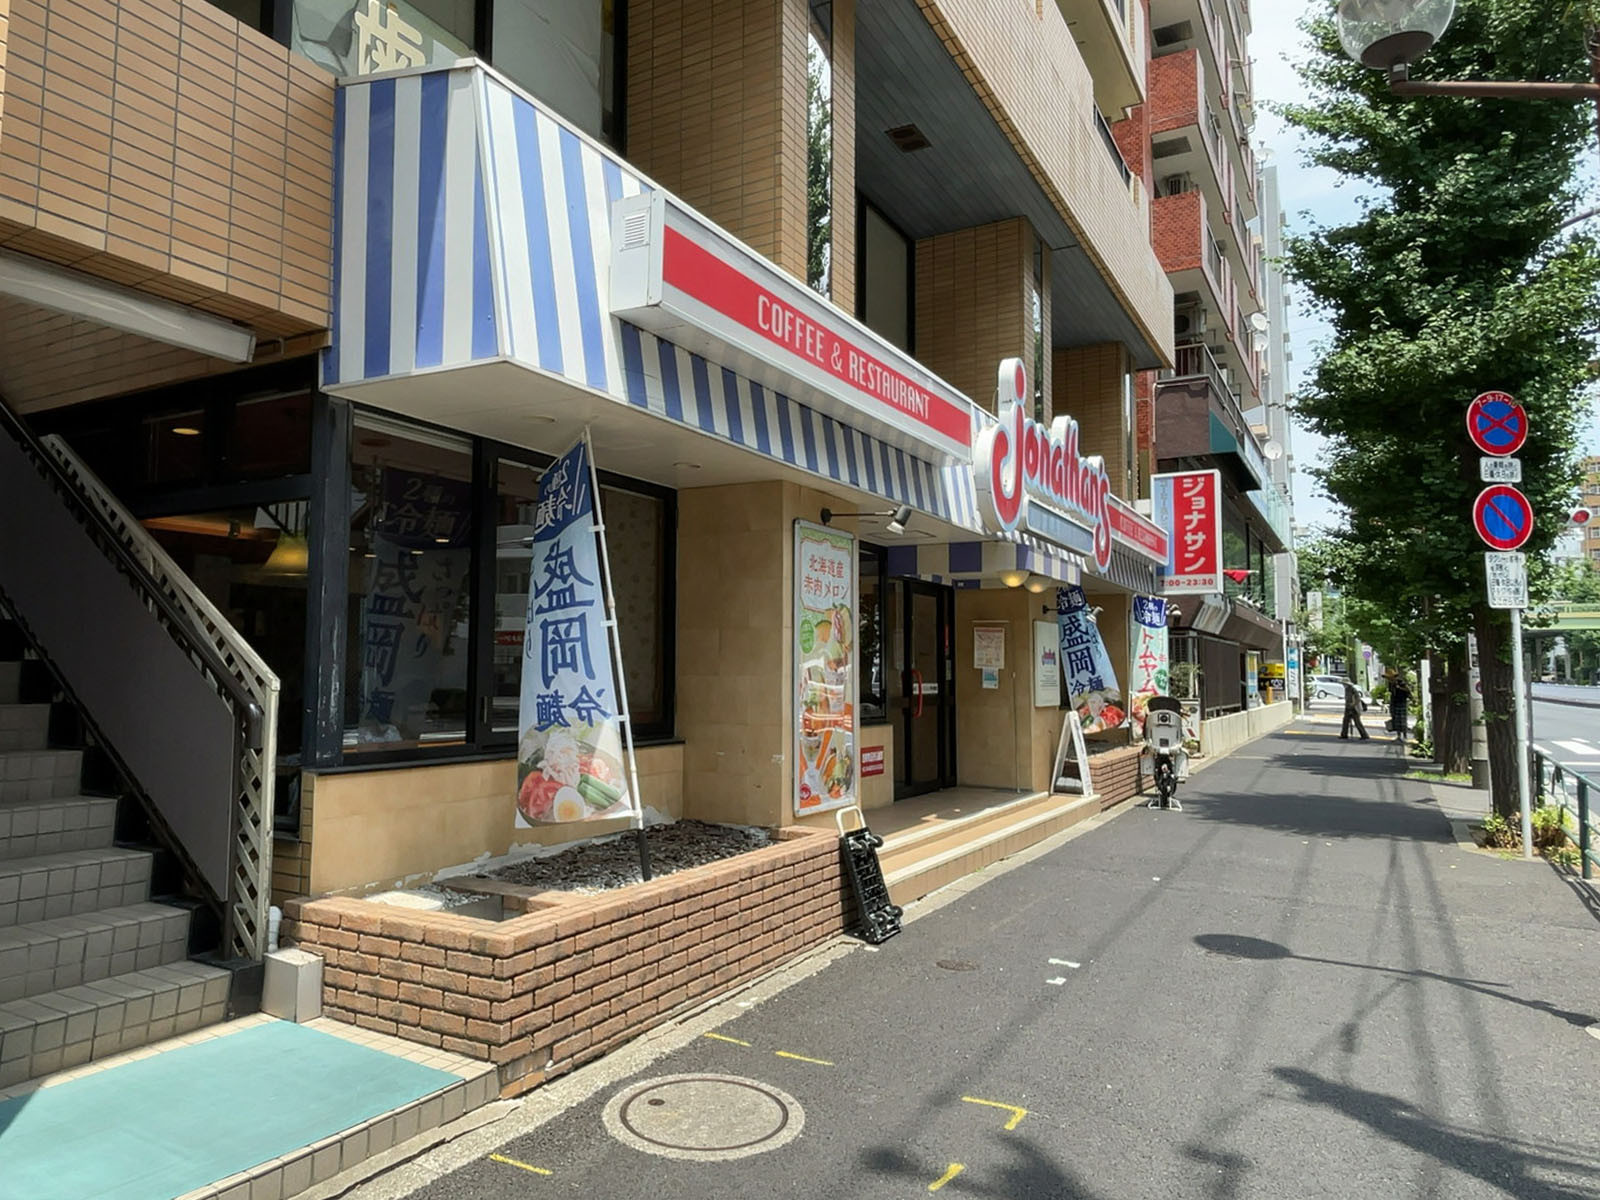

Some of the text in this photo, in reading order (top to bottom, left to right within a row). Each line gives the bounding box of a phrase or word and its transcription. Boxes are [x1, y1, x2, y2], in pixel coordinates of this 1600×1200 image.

[757, 294, 931, 420] COFFEE & RESTAURANT
[1182, 476, 1206, 573] ジョナサン
[808, 554, 845, 579] 北海道産
[1061, 614, 1097, 680] 盛岡
[1070, 675, 1105, 697] 冷麺
